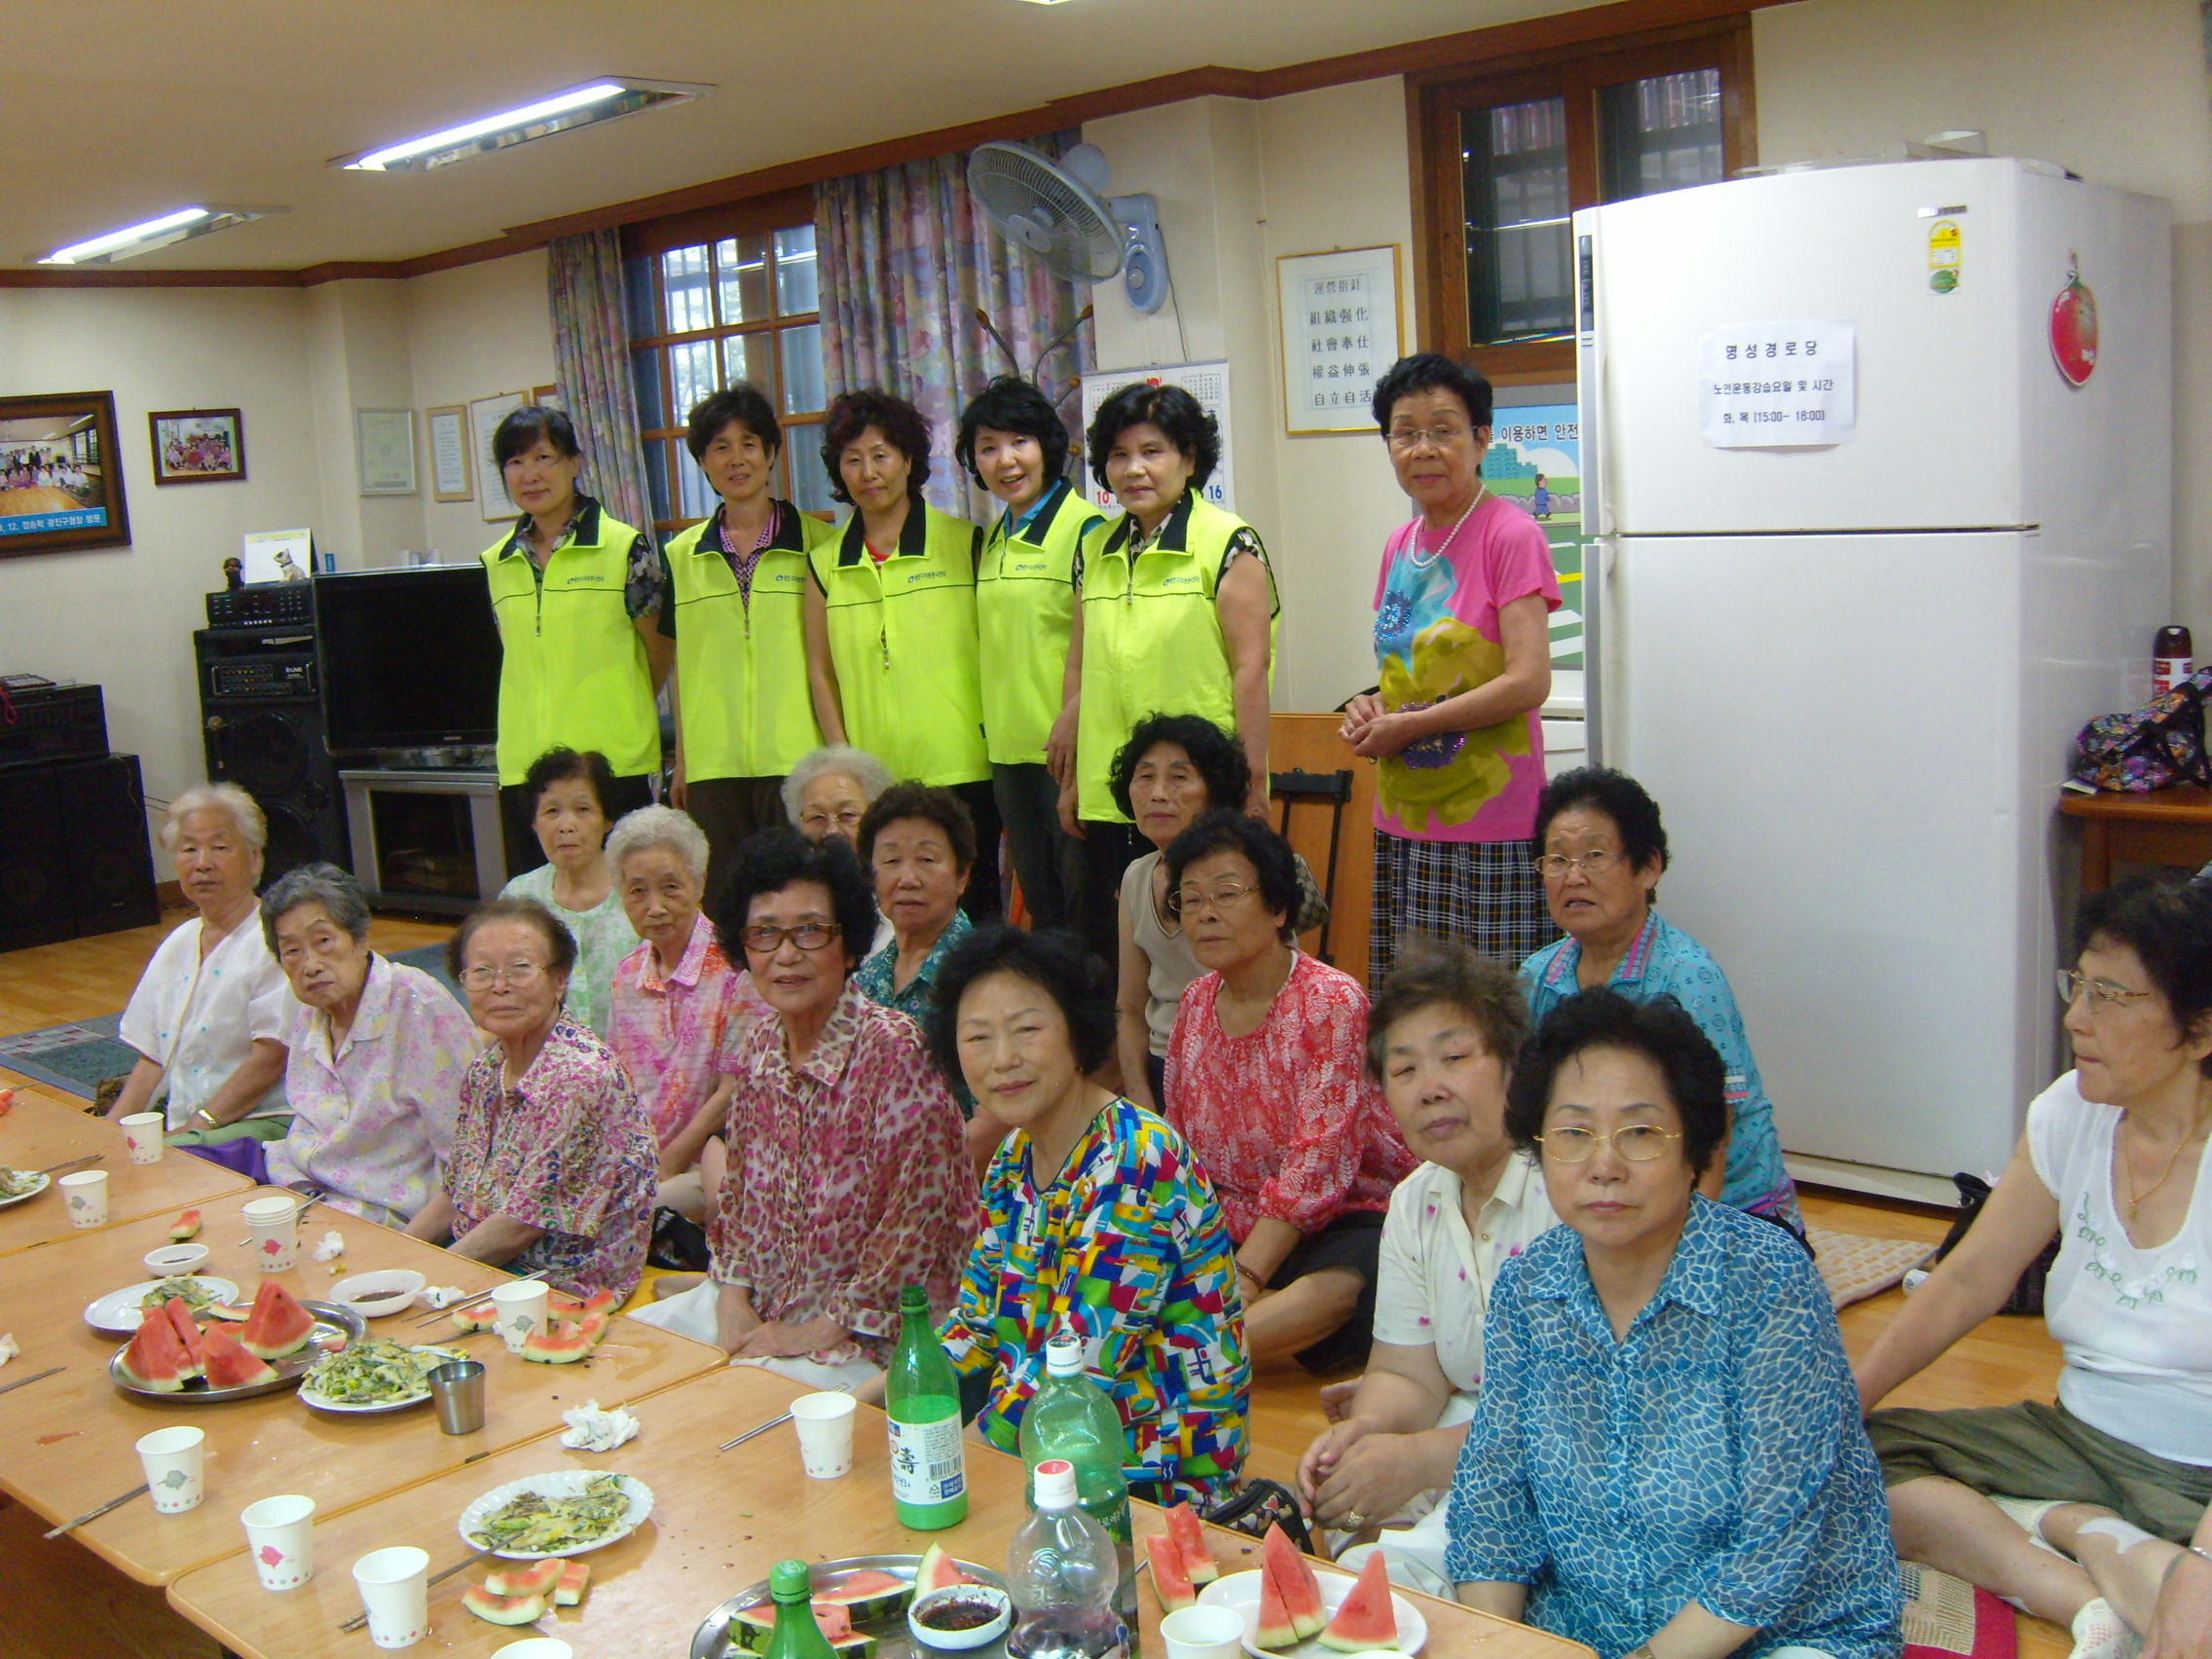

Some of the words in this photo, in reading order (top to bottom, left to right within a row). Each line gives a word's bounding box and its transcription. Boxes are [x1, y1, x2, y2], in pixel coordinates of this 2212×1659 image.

[1714, 381, 1791, 394] 노인운동강습요일
[1812, 379, 1833, 391] 시간
[1501, 424, 1548, 442] 이용하면
[1096, 491, 1110, 504] 10
[1209, 485, 1222, 499] 16
